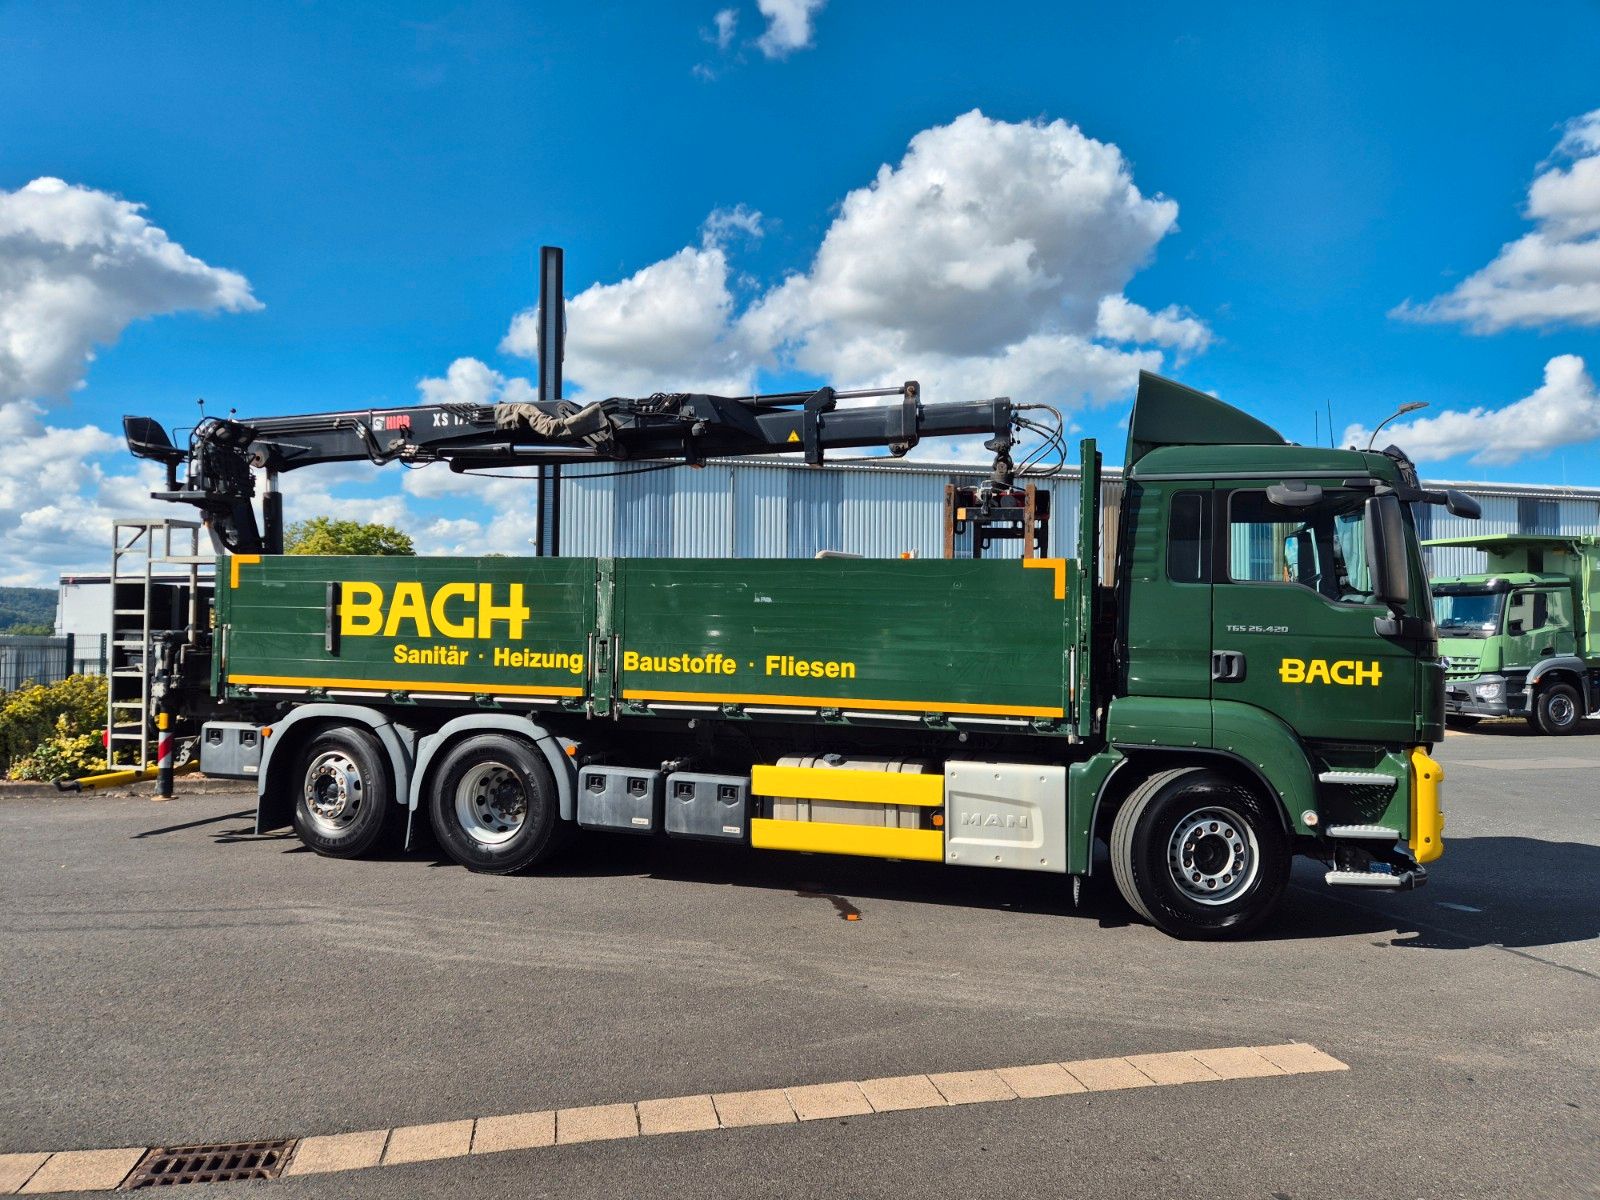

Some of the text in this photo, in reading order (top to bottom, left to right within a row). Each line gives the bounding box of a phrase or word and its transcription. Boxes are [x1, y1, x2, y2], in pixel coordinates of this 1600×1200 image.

[432, 412, 449, 427] XS
[337, 581, 530, 640] BACH
[1248, 625, 1289, 633] 26.420
[393, 643, 856, 679] Sanitär Heizung Baustoffe Fliesen
[1279, 658, 1383, 686] BACH
[961, 812, 1028, 829] MAN
